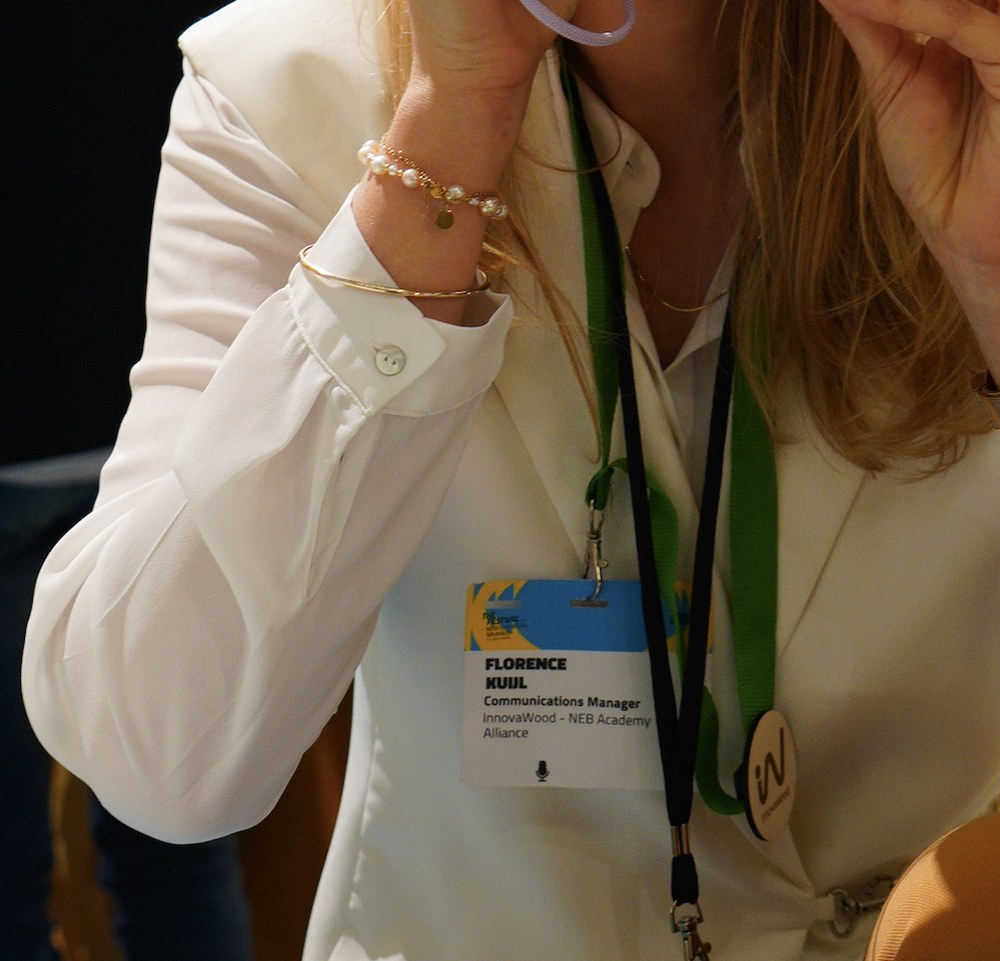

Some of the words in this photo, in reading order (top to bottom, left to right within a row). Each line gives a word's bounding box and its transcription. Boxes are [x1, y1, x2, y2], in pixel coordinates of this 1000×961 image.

[485, 658, 567, 671] FLORENCE
[485, 676, 527, 690] KUIJL
[484, 695, 584, 707] Communications
[587, 697, 641, 710] Manager
[483, 712, 556, 724] InnovaWood
[568, 713, 594, 725] NEB
[597, 714, 651, 729] Academy
[484, 727, 529, 739] Alliance
